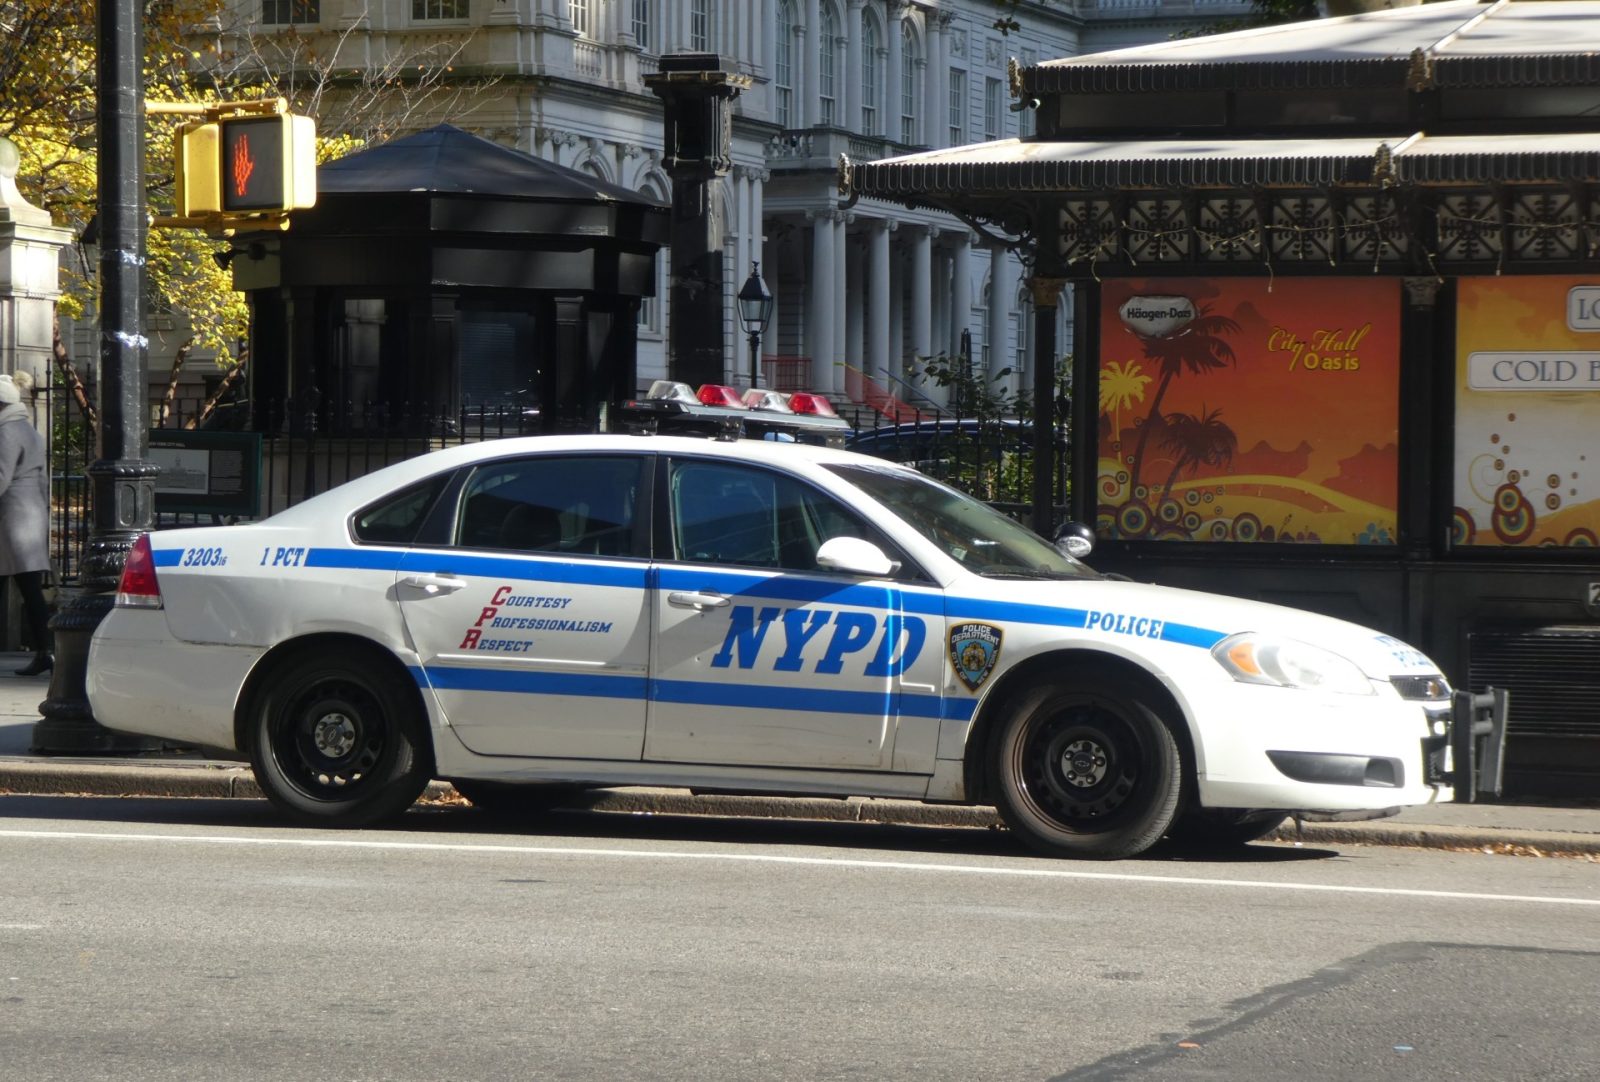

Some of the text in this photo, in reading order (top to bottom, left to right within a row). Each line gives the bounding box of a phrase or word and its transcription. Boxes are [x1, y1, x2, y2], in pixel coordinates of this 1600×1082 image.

[1267, 322, 1373, 371] City Hall
[1303, 351, 1360, 370] Oasis
[1492, 360, 1577, 382] COLD
[184, 548, 222, 566] 3203
[260, 547, 305, 566] 1 PCT
[490, 586, 572, 609] COURTESY
[474, 607, 614, 633] PROFESSIONALISM
[962, 624, 992, 635] POLICE
[1085, 610, 1162, 639] POLICE
[459, 629, 533, 652] RESPECT
[710, 605, 926, 677] NYPD
[951, 632, 1000, 645] DEPARTMENT
